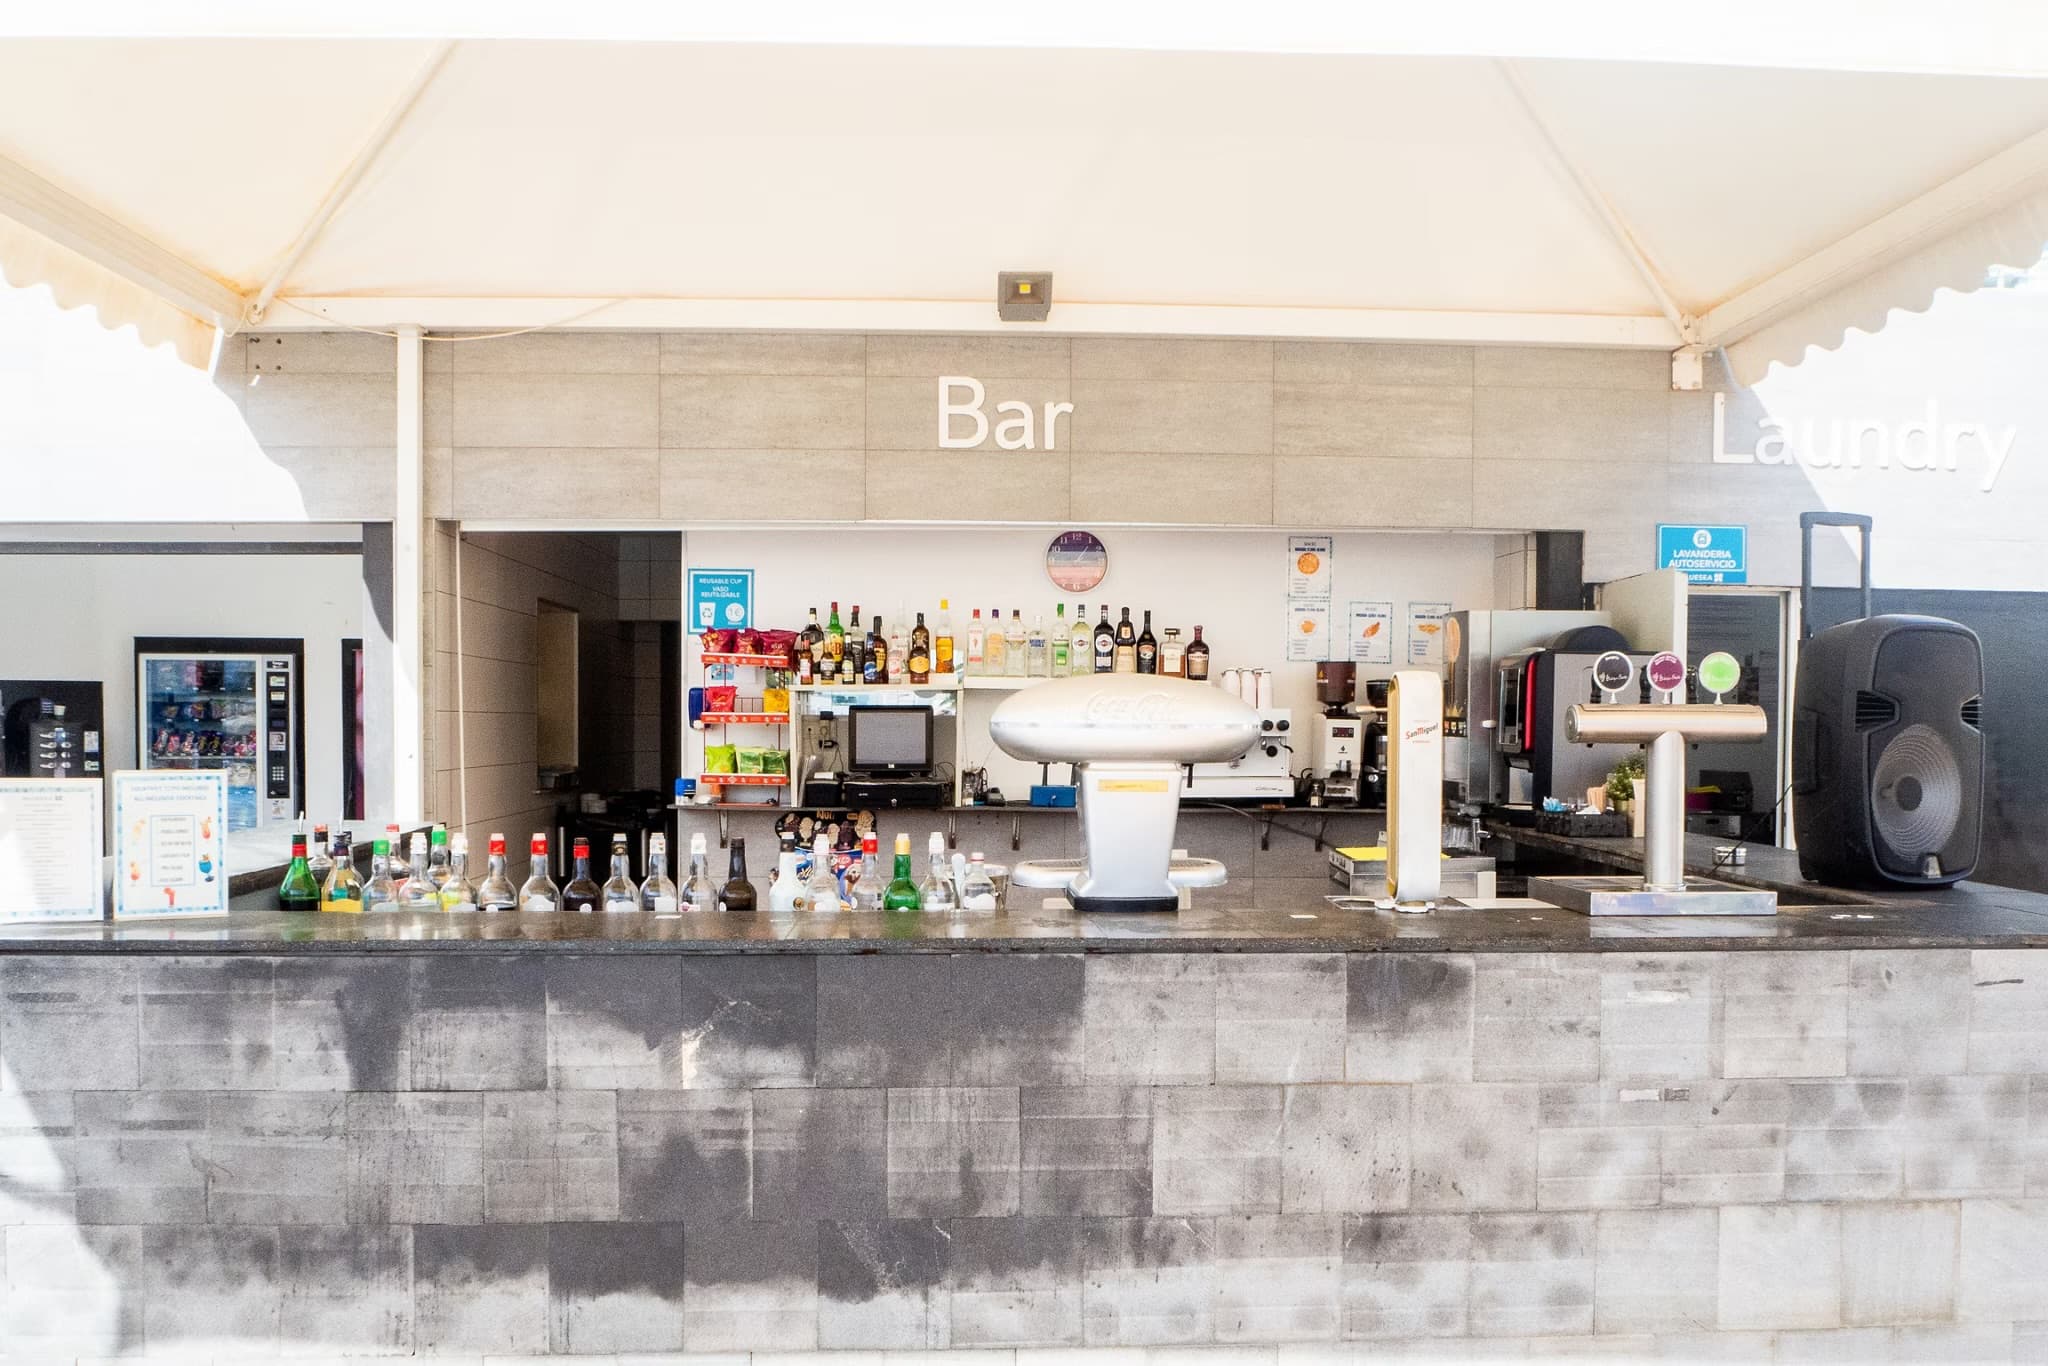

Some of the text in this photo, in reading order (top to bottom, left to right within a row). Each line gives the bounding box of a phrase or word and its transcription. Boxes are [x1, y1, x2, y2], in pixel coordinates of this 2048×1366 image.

[938, 376, 1074, 450] Bar
[1712, 391, 2017, 493] Laundry
[1668, 559, 1737, 569] AUTOSERVICIO
